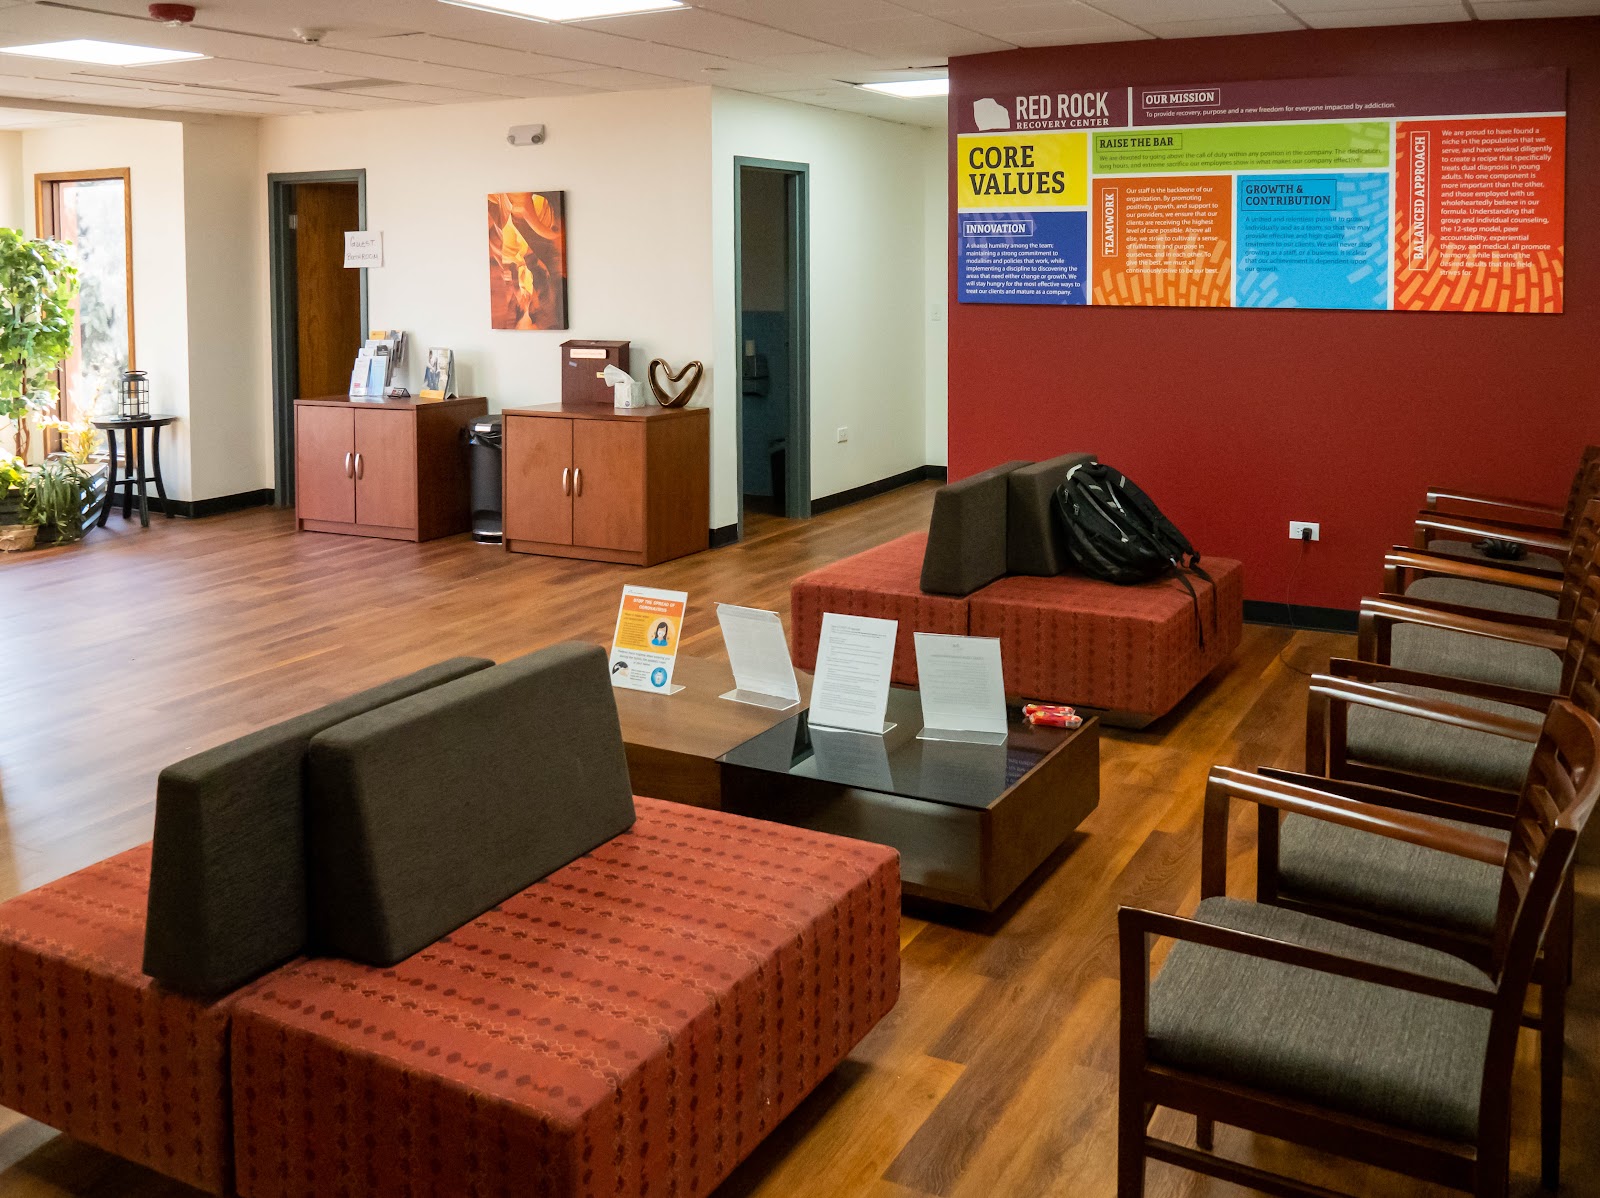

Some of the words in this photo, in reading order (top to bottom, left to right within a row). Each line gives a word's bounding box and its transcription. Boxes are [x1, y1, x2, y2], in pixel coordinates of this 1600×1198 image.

[1146, 94, 1167, 104] OUR
[1170, 92, 1214, 103] MISSION
[1016, 96, 1052, 120] RED
[1058, 92, 1109, 118] ROCK
[1325, 104, 1354, 112] impacted
[1016, 120, 1067, 129] RECOVERY
[1070, 118, 1109, 127] CENTER
[1100, 139, 1128, 148] RAISE
[1131, 138, 1151, 147] THE
[1153, 137, 1174, 146] BAR
[969, 145, 1035, 170] CORE
[1201, 160, 1232, 168] employees
[1414, 136, 1425, 197] APPROACH
[969, 171, 1065, 195] VALUES
[1246, 185, 1294, 194] GROWTH
[1296, 184, 1303, 194] &
[1246, 196, 1331, 206] CONTRIBUTION
[966, 224, 1025, 233] INNOVATION
[1105, 193, 1114, 254] TEAMWORK
[1414, 199, 1425, 260] BALANCED
